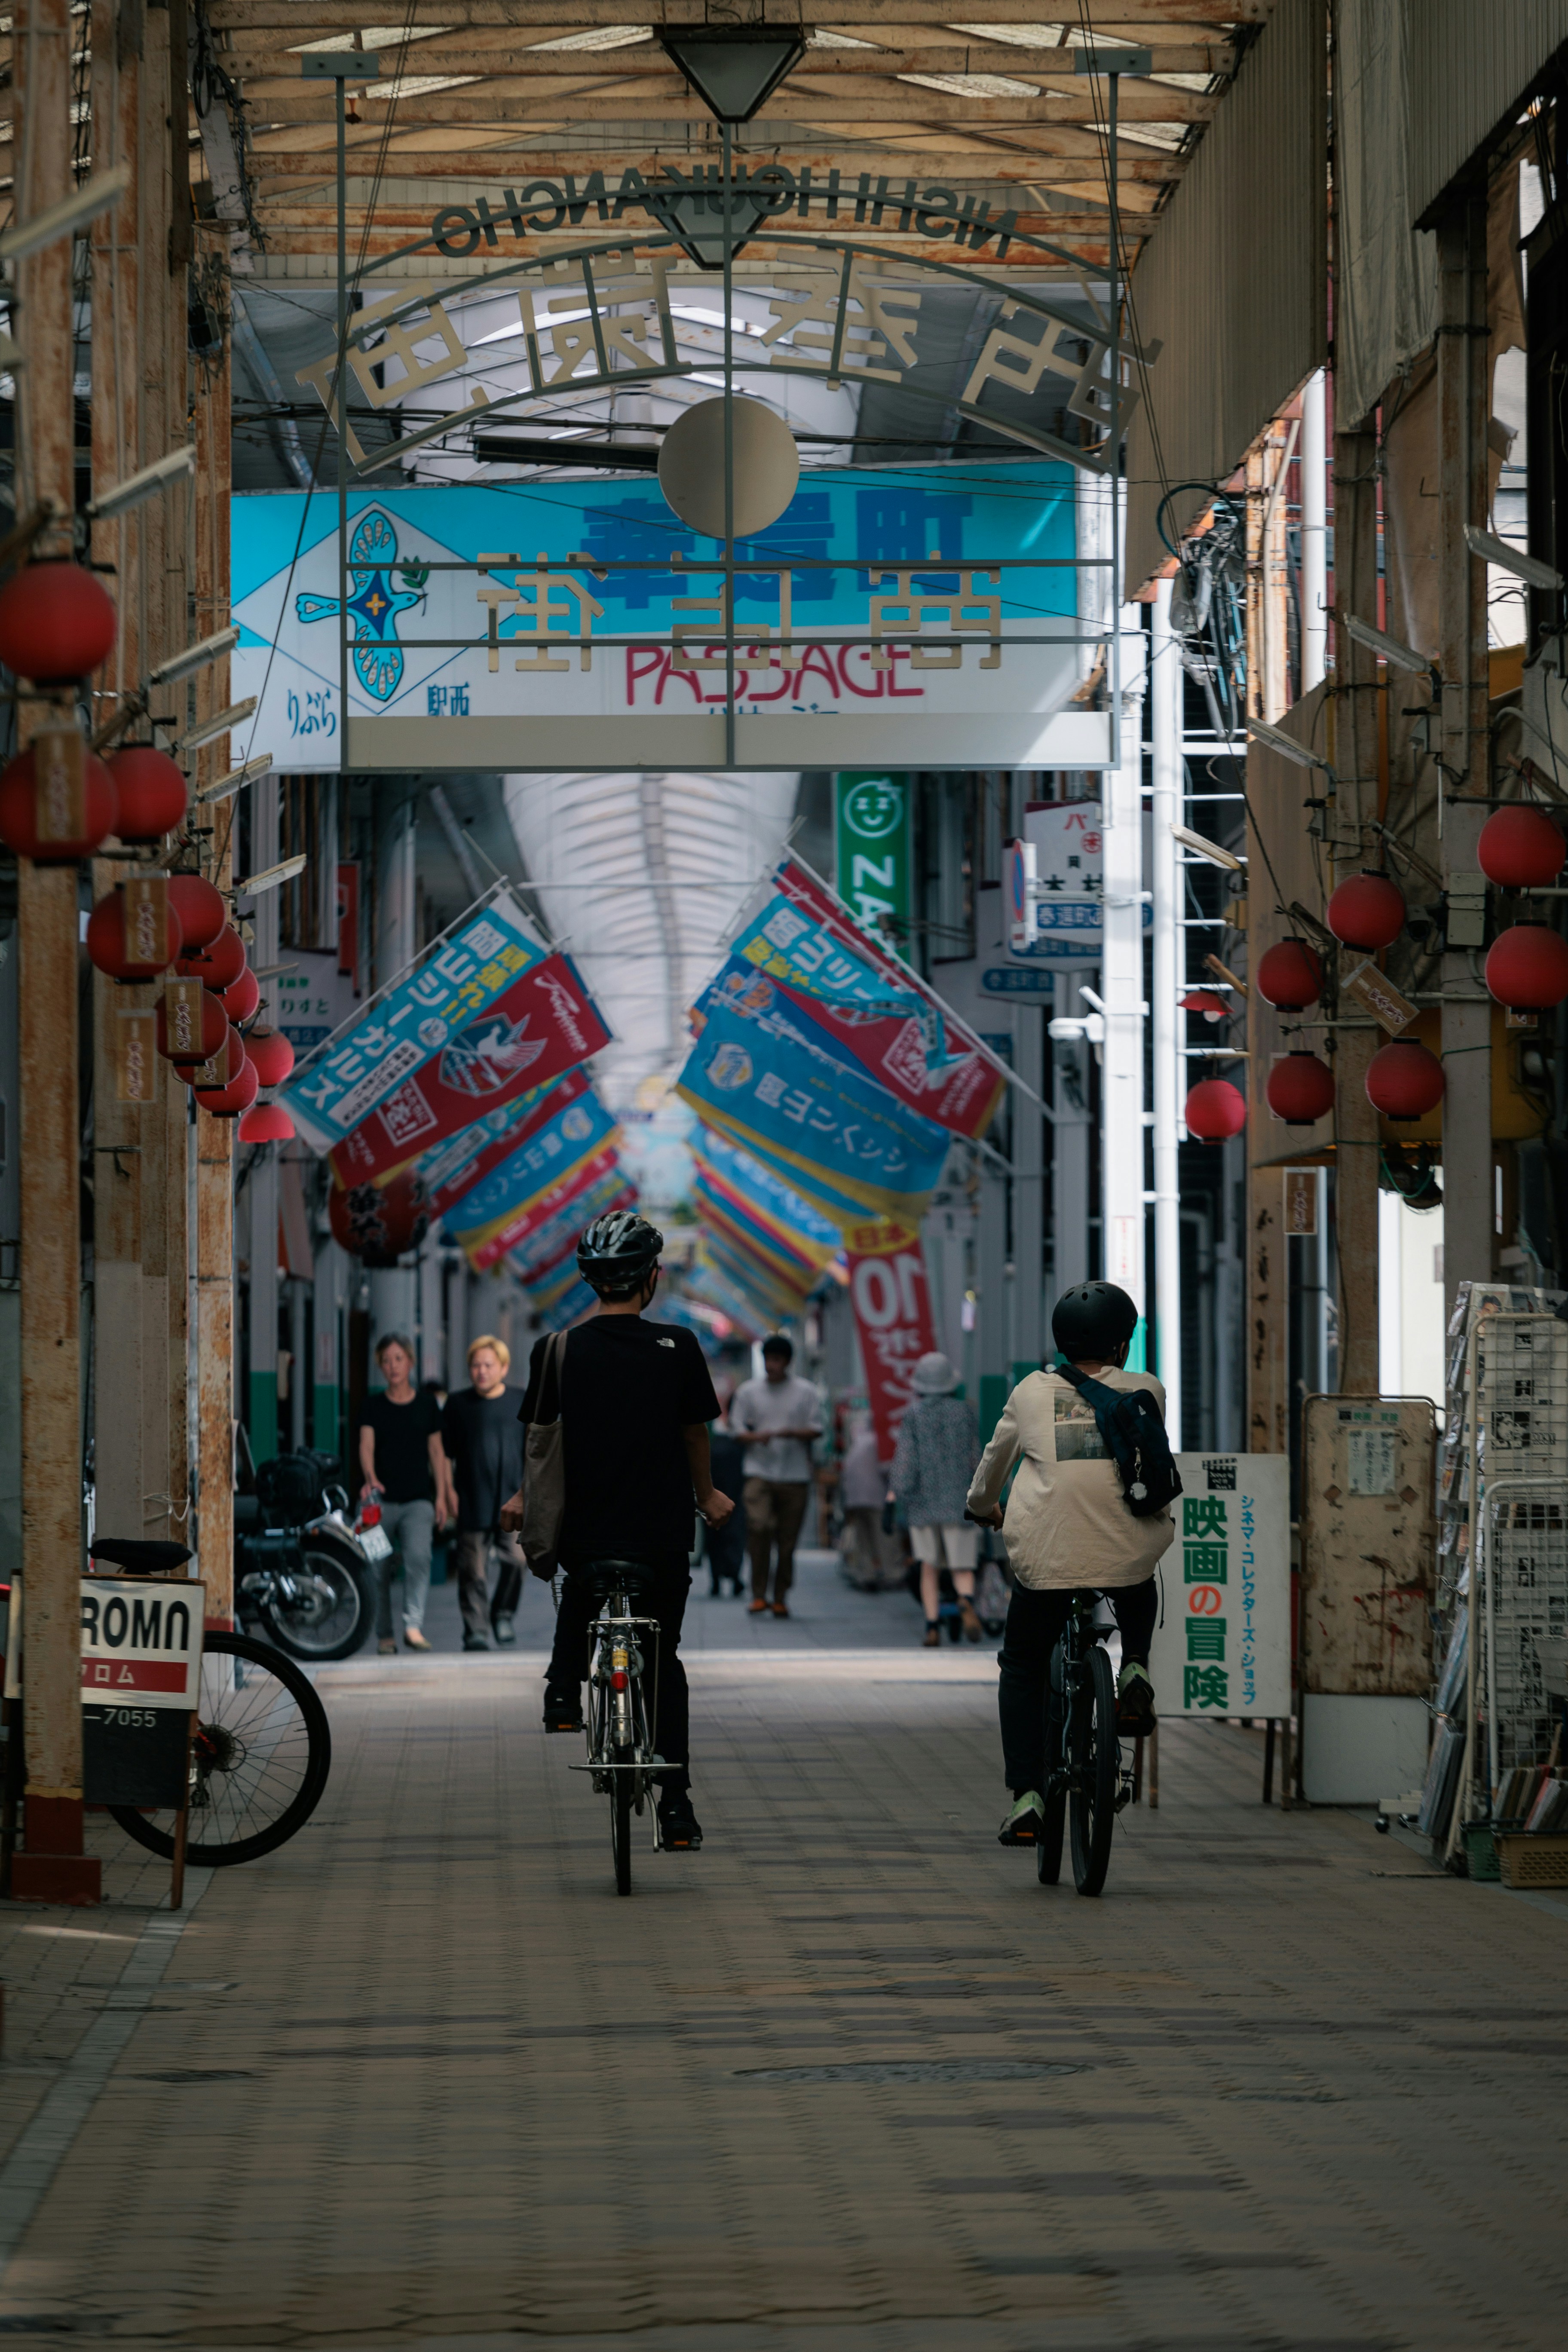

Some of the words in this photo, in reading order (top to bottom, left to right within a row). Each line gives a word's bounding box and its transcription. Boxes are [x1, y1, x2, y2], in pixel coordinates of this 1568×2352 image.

[427, 682, 470, 715] 駅西
[626, 635, 925, 704] PASSAGE
[299, 920, 508, 1110] 岡山シーガルズ
[1183, 1495, 1229, 1710] 映画の冒険
